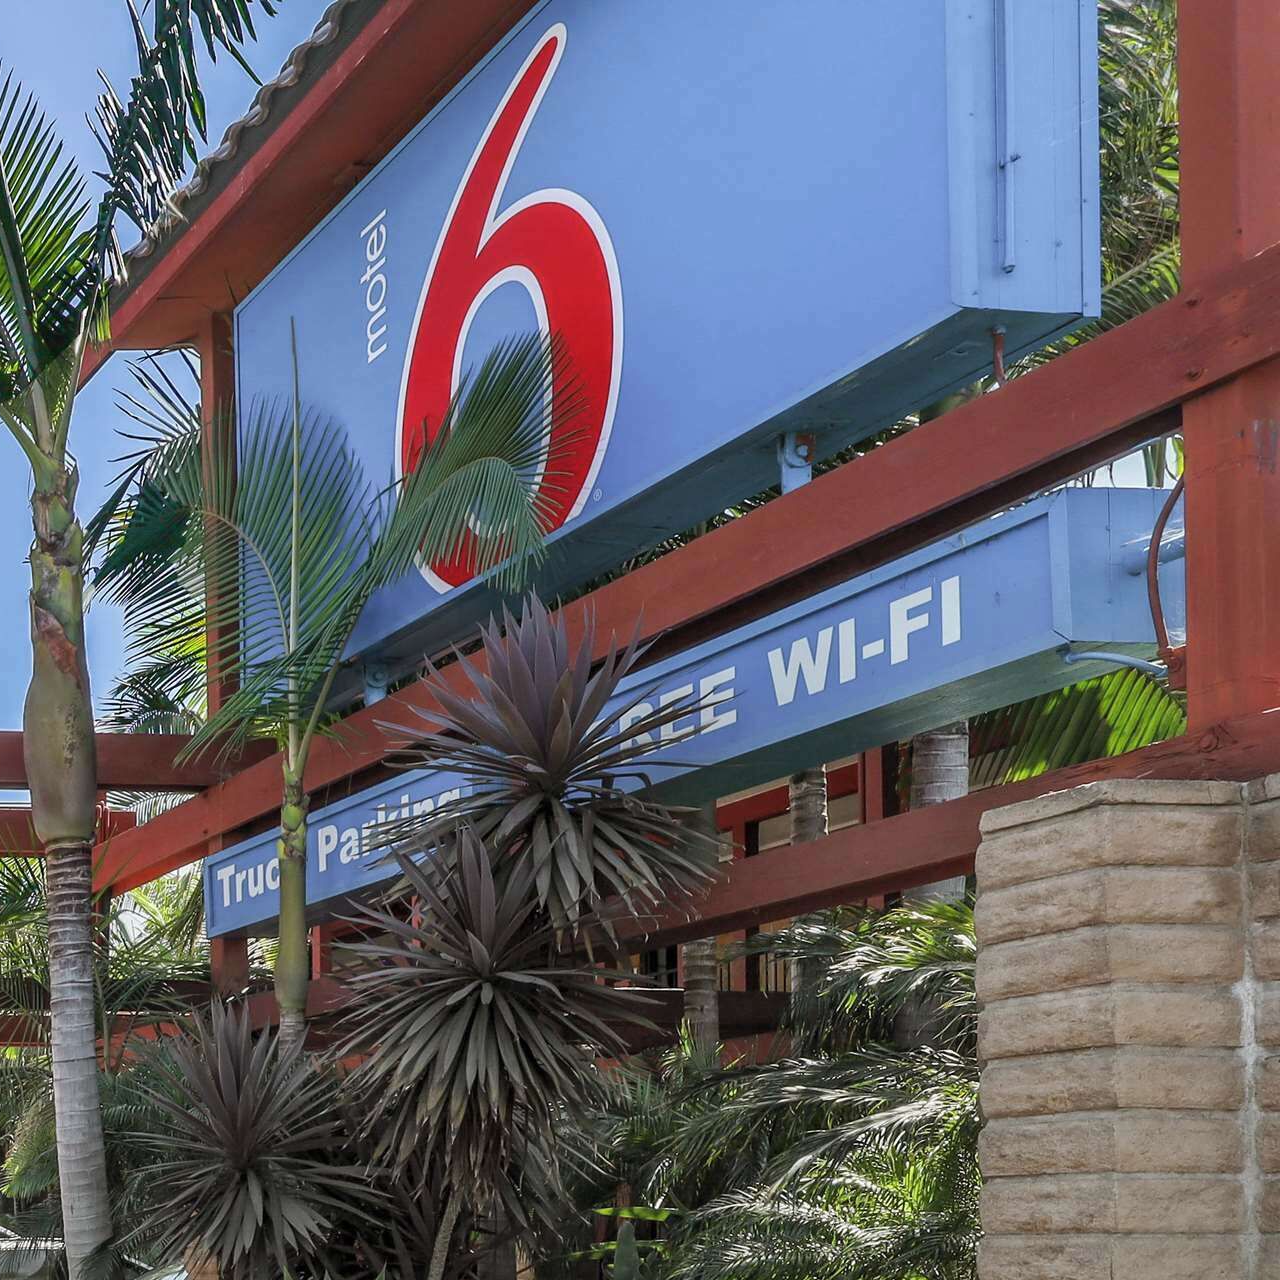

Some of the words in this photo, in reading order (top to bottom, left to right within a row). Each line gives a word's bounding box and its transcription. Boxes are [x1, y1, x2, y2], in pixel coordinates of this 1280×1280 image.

[360, 208, 387, 364] motel
[395, 22, 624, 594] 6
[217, 857, 280, 907] Truc
[582, 666, 737, 763] REE
[767, 575, 962, 706] WI-FI
